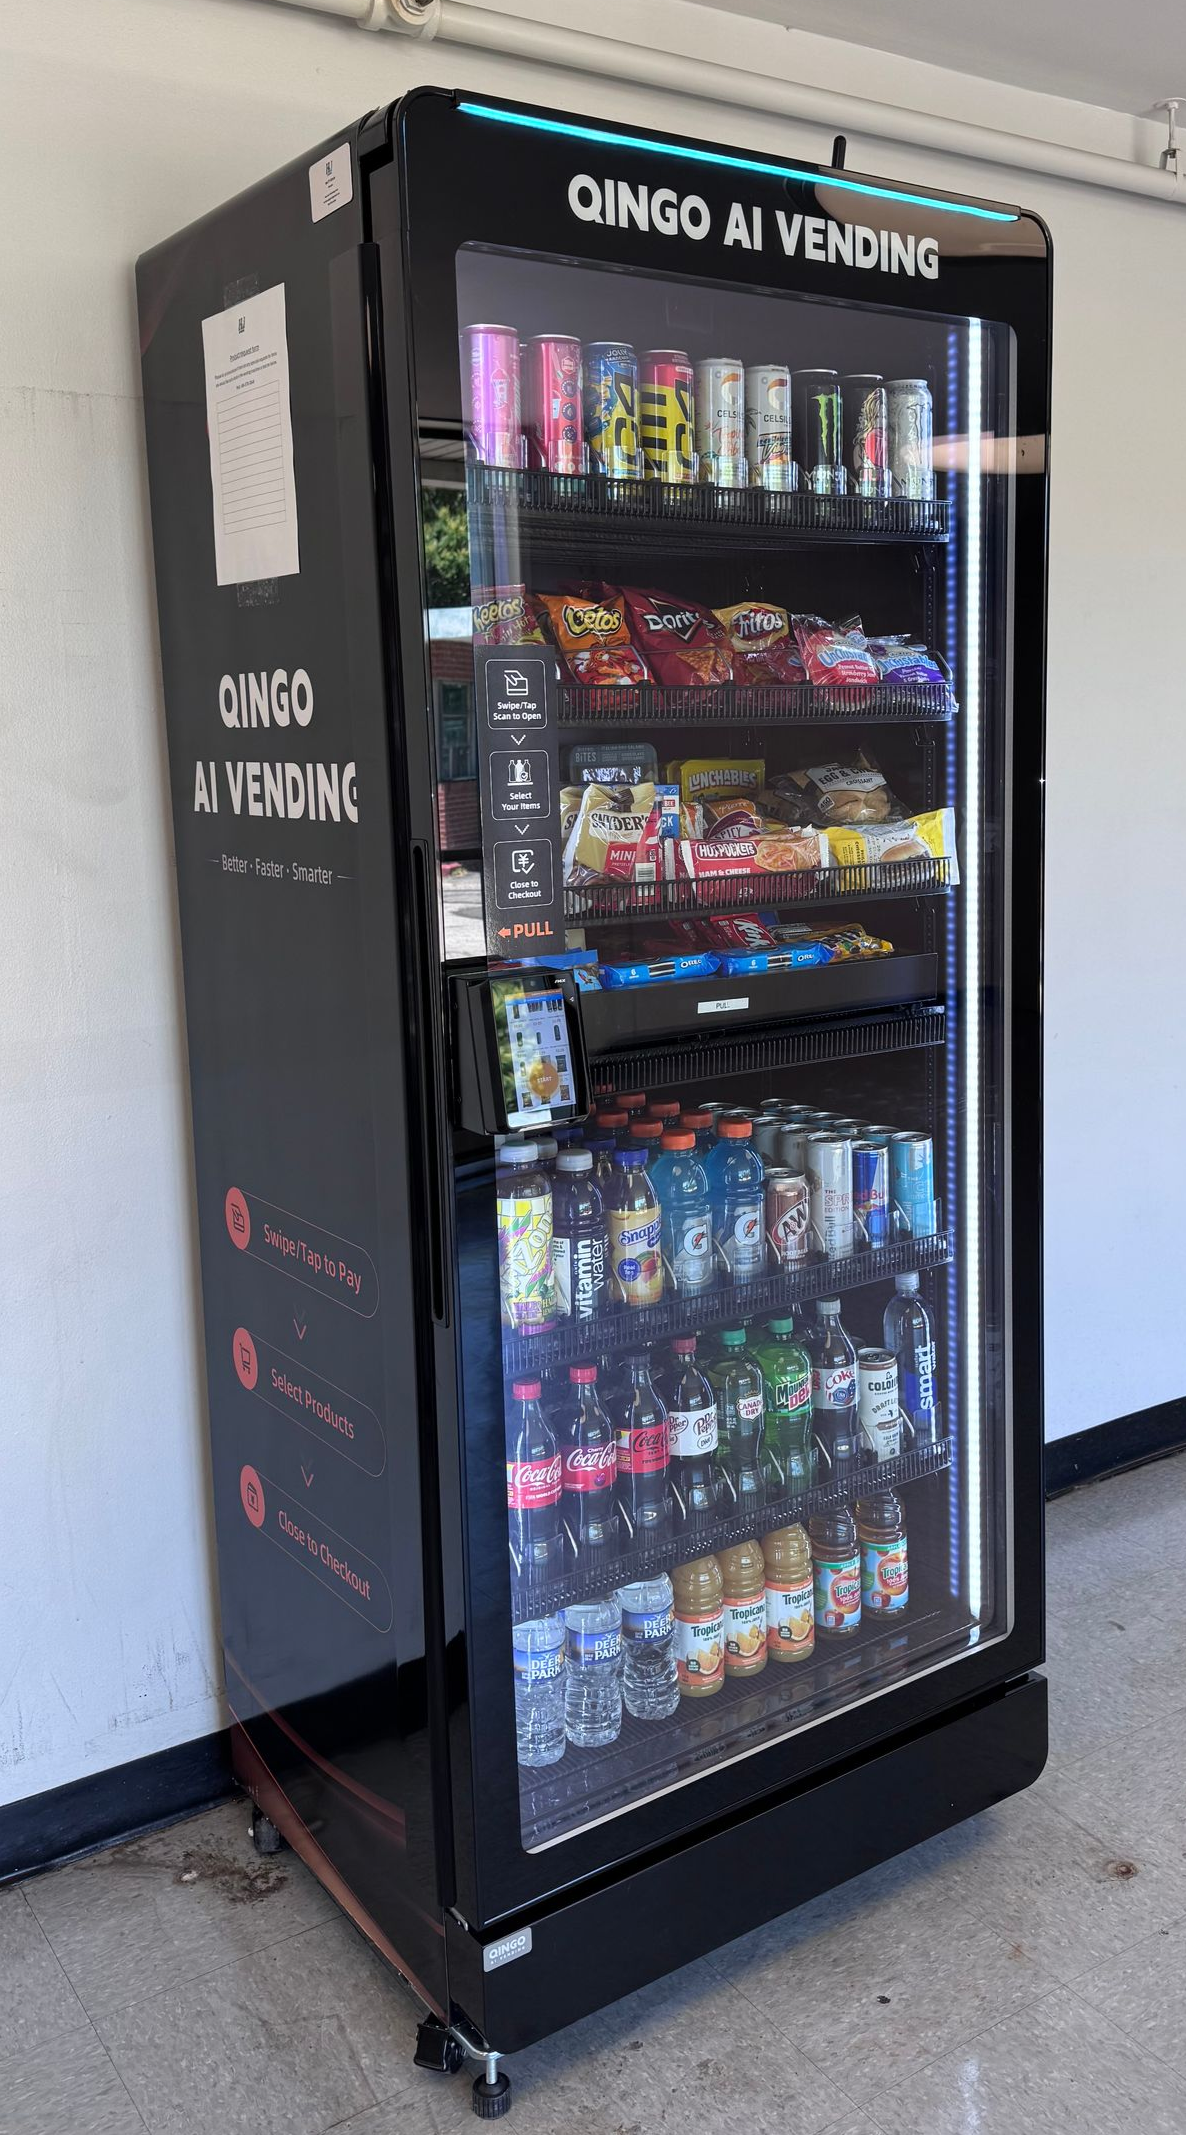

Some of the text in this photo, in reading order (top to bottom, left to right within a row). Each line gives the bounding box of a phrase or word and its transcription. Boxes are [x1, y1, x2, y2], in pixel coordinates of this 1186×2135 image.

[568, 173, 940, 280] QINGO AI VENDING
[471, 597, 522, 632] heetos
[732, 609, 784, 639] Fritos
[218, 668, 314, 728] QINGO
[497, 702, 537, 711] Swipe/Tap
[493, 712, 542, 721] Scan to Open
[689, 769, 756, 792] LUNCHABLES
[819, 772, 840, 785] EGG
[840, 770, 851, 778] &
[846, 777, 874, 786] CROISSANT
[194, 761, 359, 824] AI VENDING
[509, 792, 532, 800] Select
[501, 802, 541, 811] Your Items
[222, 854, 333, 885] Better Faster Smarter
[725, 867, 751, 875] CHEESE
[510, 880, 539, 889] Close to
[508, 890, 542, 900] Checkout
[513, 921, 554, 939] PULL
[630, 968, 637, 976] 6
[825, 1194, 850, 1207] SPR
[619, 1217, 661, 1246] Snapp
[264, 1223, 361, 1295] Swipe/Tap to Pay
[592, 1239, 604, 1292] water
[574, 1239, 593, 1319] vitamin
[914, 1344, 934, 1410] smart
[271, 1368, 354, 1439] Select Products
[745, 1408, 760, 1417] DRY
[696, 1416, 717, 1437] Pepp
[278, 1510, 371, 1601] Close to Checkout
[781, 1588, 814, 1605] Tropica
[644, 1613, 672, 1630] DEER
[644, 1624, 673, 1639] PARK
[594, 1633, 621, 1651] DEER
[531, 1654, 561, 1670] DEER
[531, 1665, 561, 1680] PARK
[489, 1935, 526, 1959] QINGO
